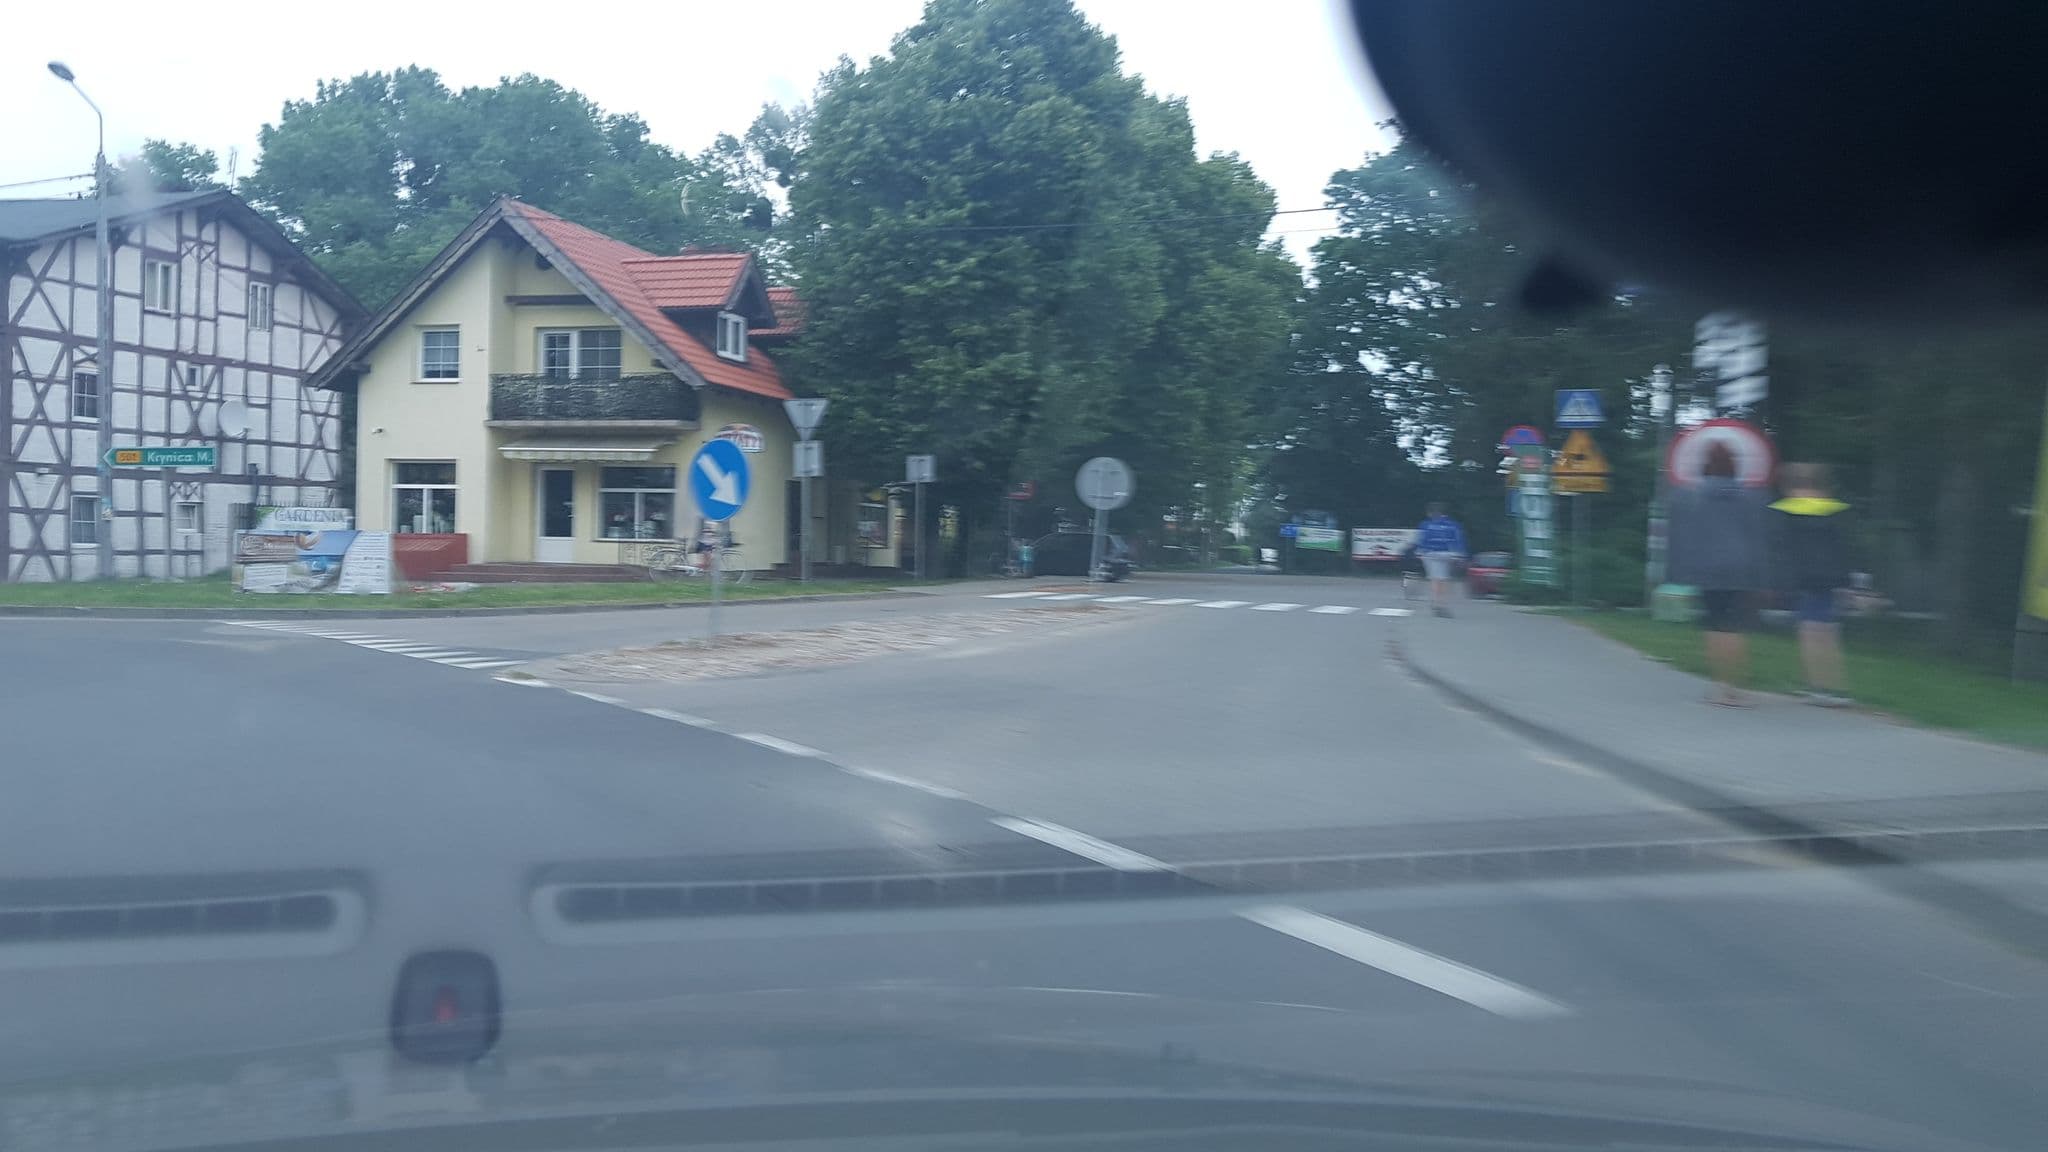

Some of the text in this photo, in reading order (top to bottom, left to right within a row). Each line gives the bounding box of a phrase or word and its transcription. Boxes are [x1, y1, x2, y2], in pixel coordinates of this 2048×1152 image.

[147, 451, 193, 464] Krynica
[197, 451, 212, 462] M.
[274, 509, 346, 522] GARDENIA
